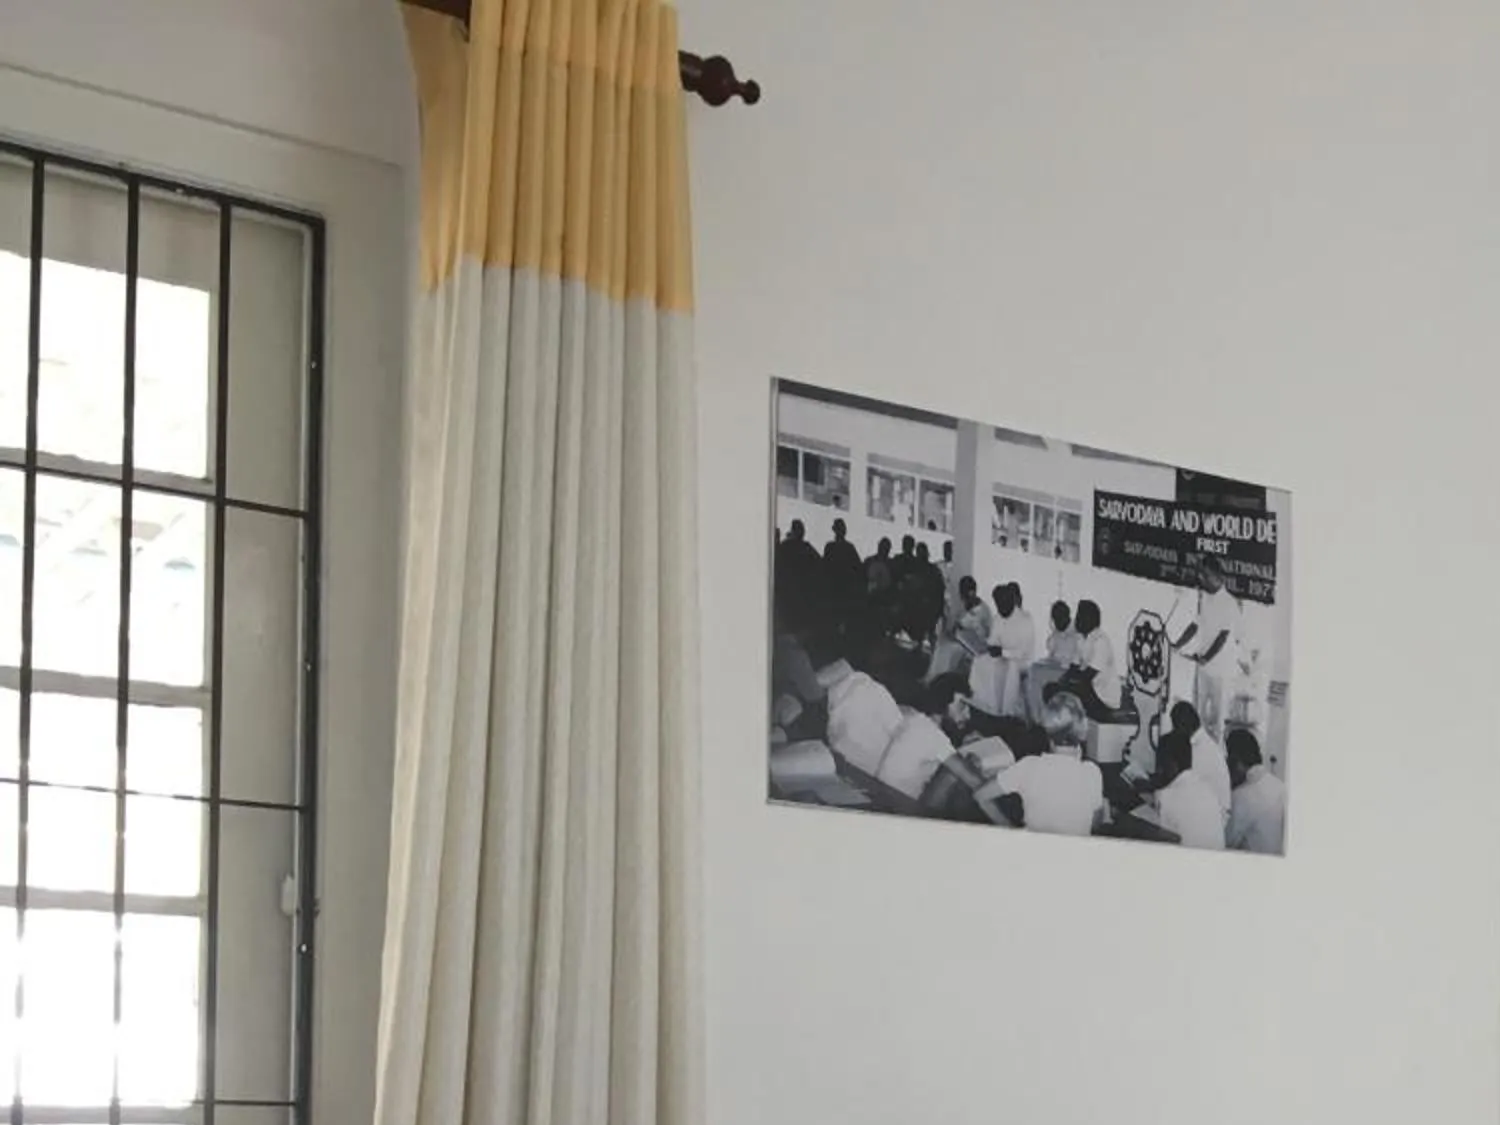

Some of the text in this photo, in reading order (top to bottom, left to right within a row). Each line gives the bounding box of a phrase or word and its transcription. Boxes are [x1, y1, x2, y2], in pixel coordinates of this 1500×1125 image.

[1098, 498, 1165, 529] SARVODAYA
[1169, 508, 1199, 533] AND
[1202, 512, 1253, 540] WORLD
[1197, 537, 1231, 555] FIRST
